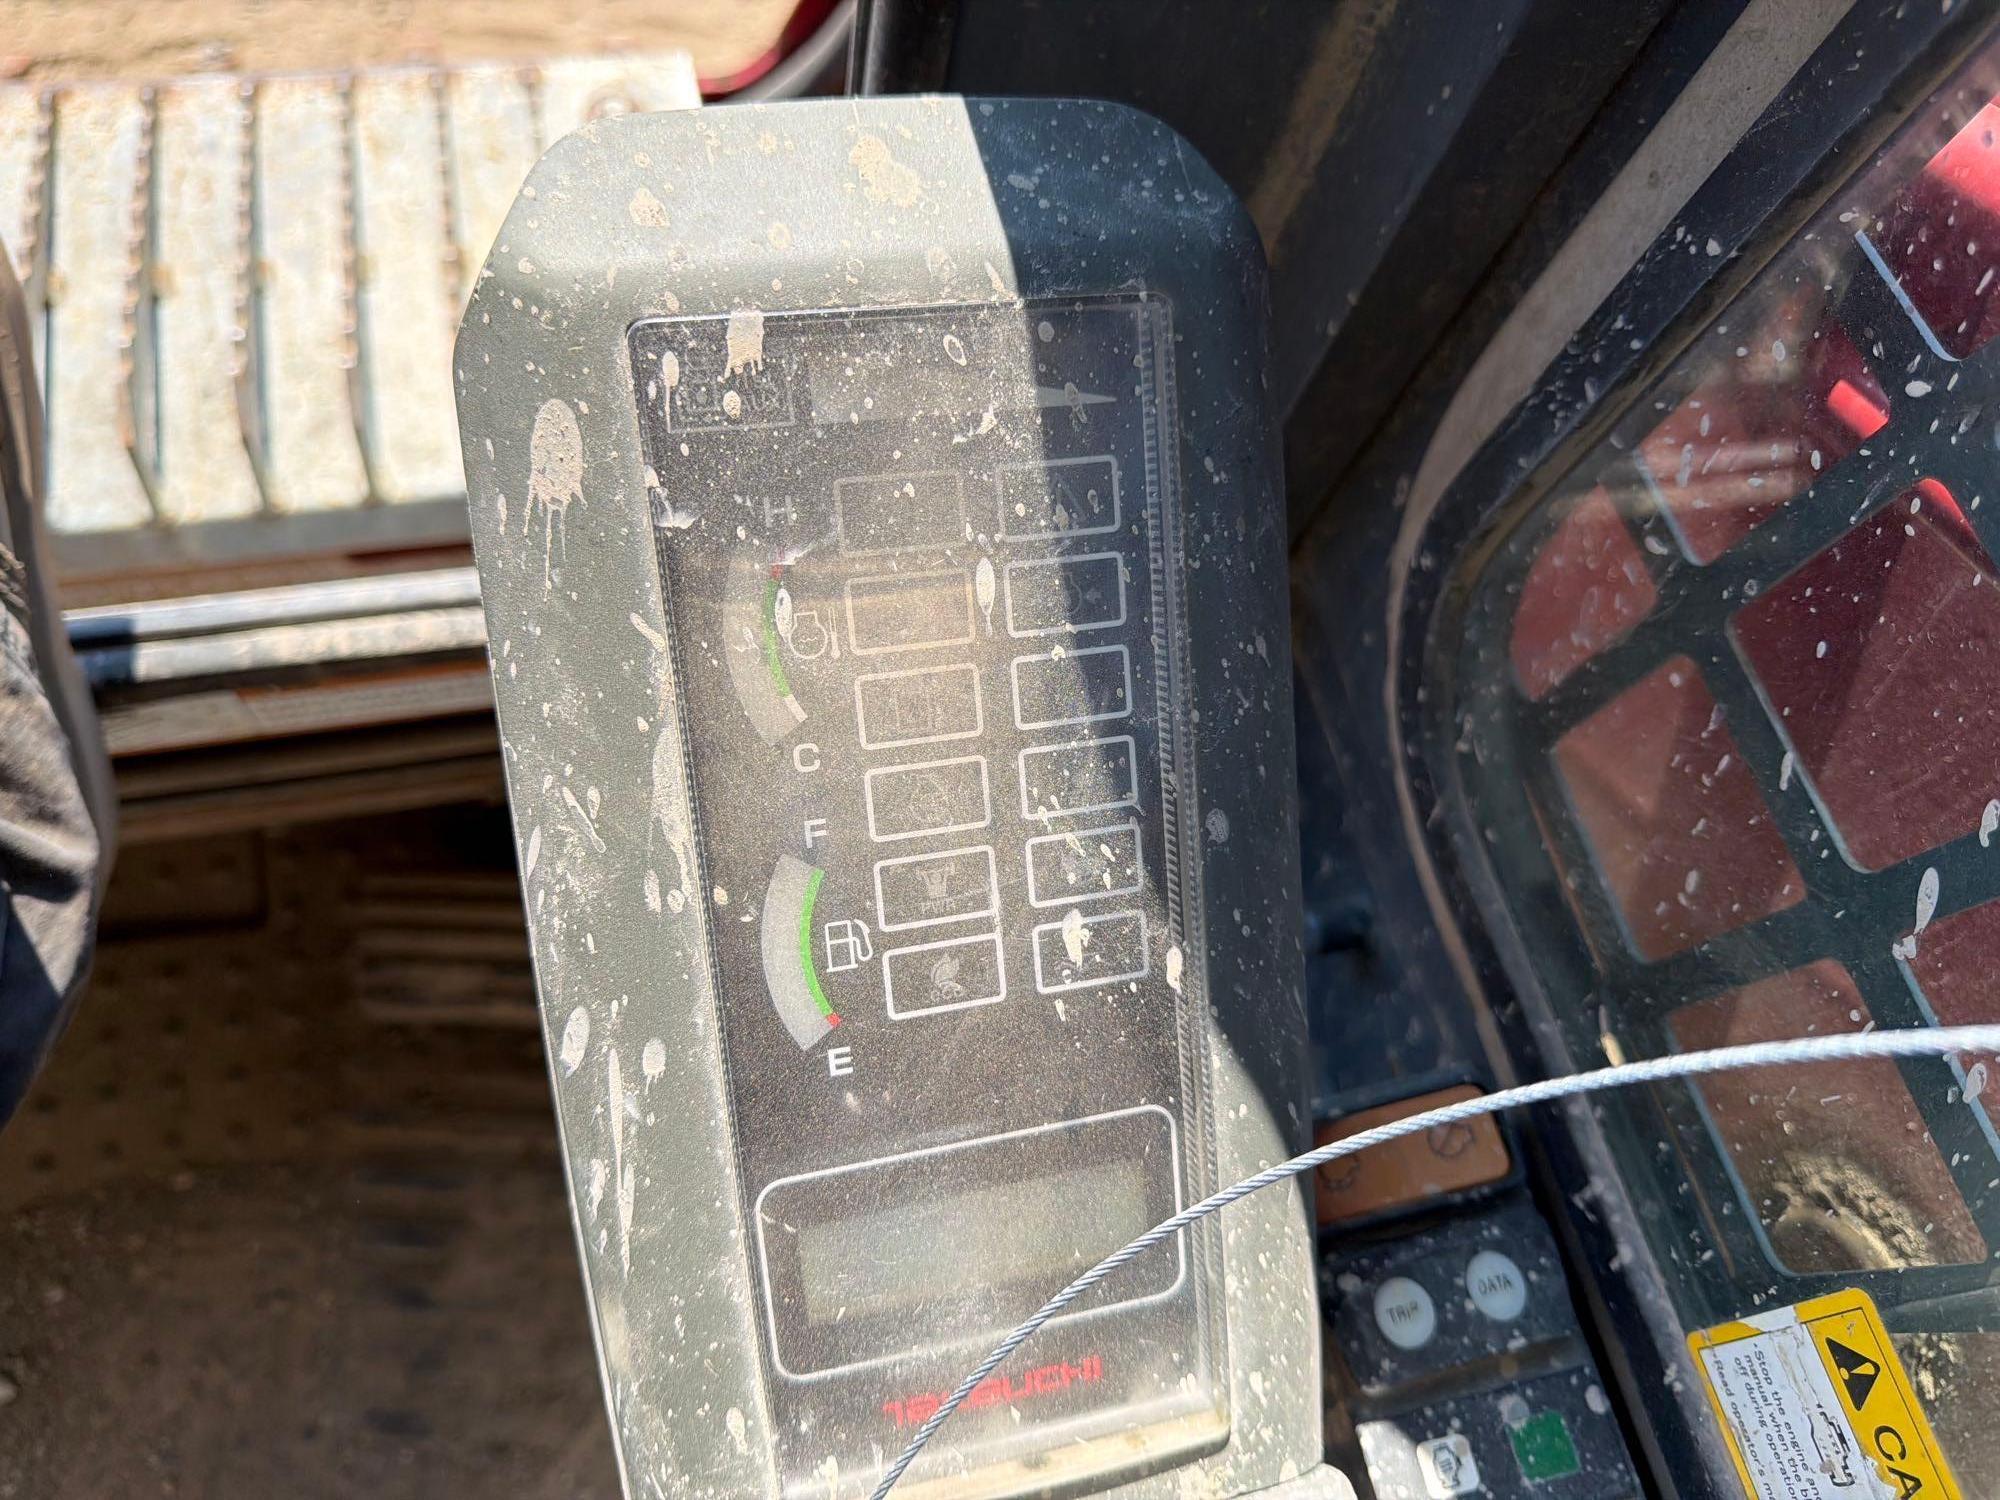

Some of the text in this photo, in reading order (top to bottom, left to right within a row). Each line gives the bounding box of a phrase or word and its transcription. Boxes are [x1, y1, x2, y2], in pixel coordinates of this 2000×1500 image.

[763, 494, 794, 528] H
[793, 742, 821, 772] C
[804, 818, 827, 849] F
[827, 1046, 854, 1077] E
[1477, 1272, 1513, 1296] DATA
[1385, 1300, 1419, 1325] TRIP
[1734, 1357, 1750, 1377] off
[1745, 1382, 1768, 1429] during
[1744, 1355, 1772, 1407] manual
[1769, 1412, 1789, 1452] when
[1787, 1457, 1802, 1482] the
[1771, 1391, 1786, 1416] the
[1784, 1421, 1810, 1472] engine
[1807, 1477, 1822, 1500] an
